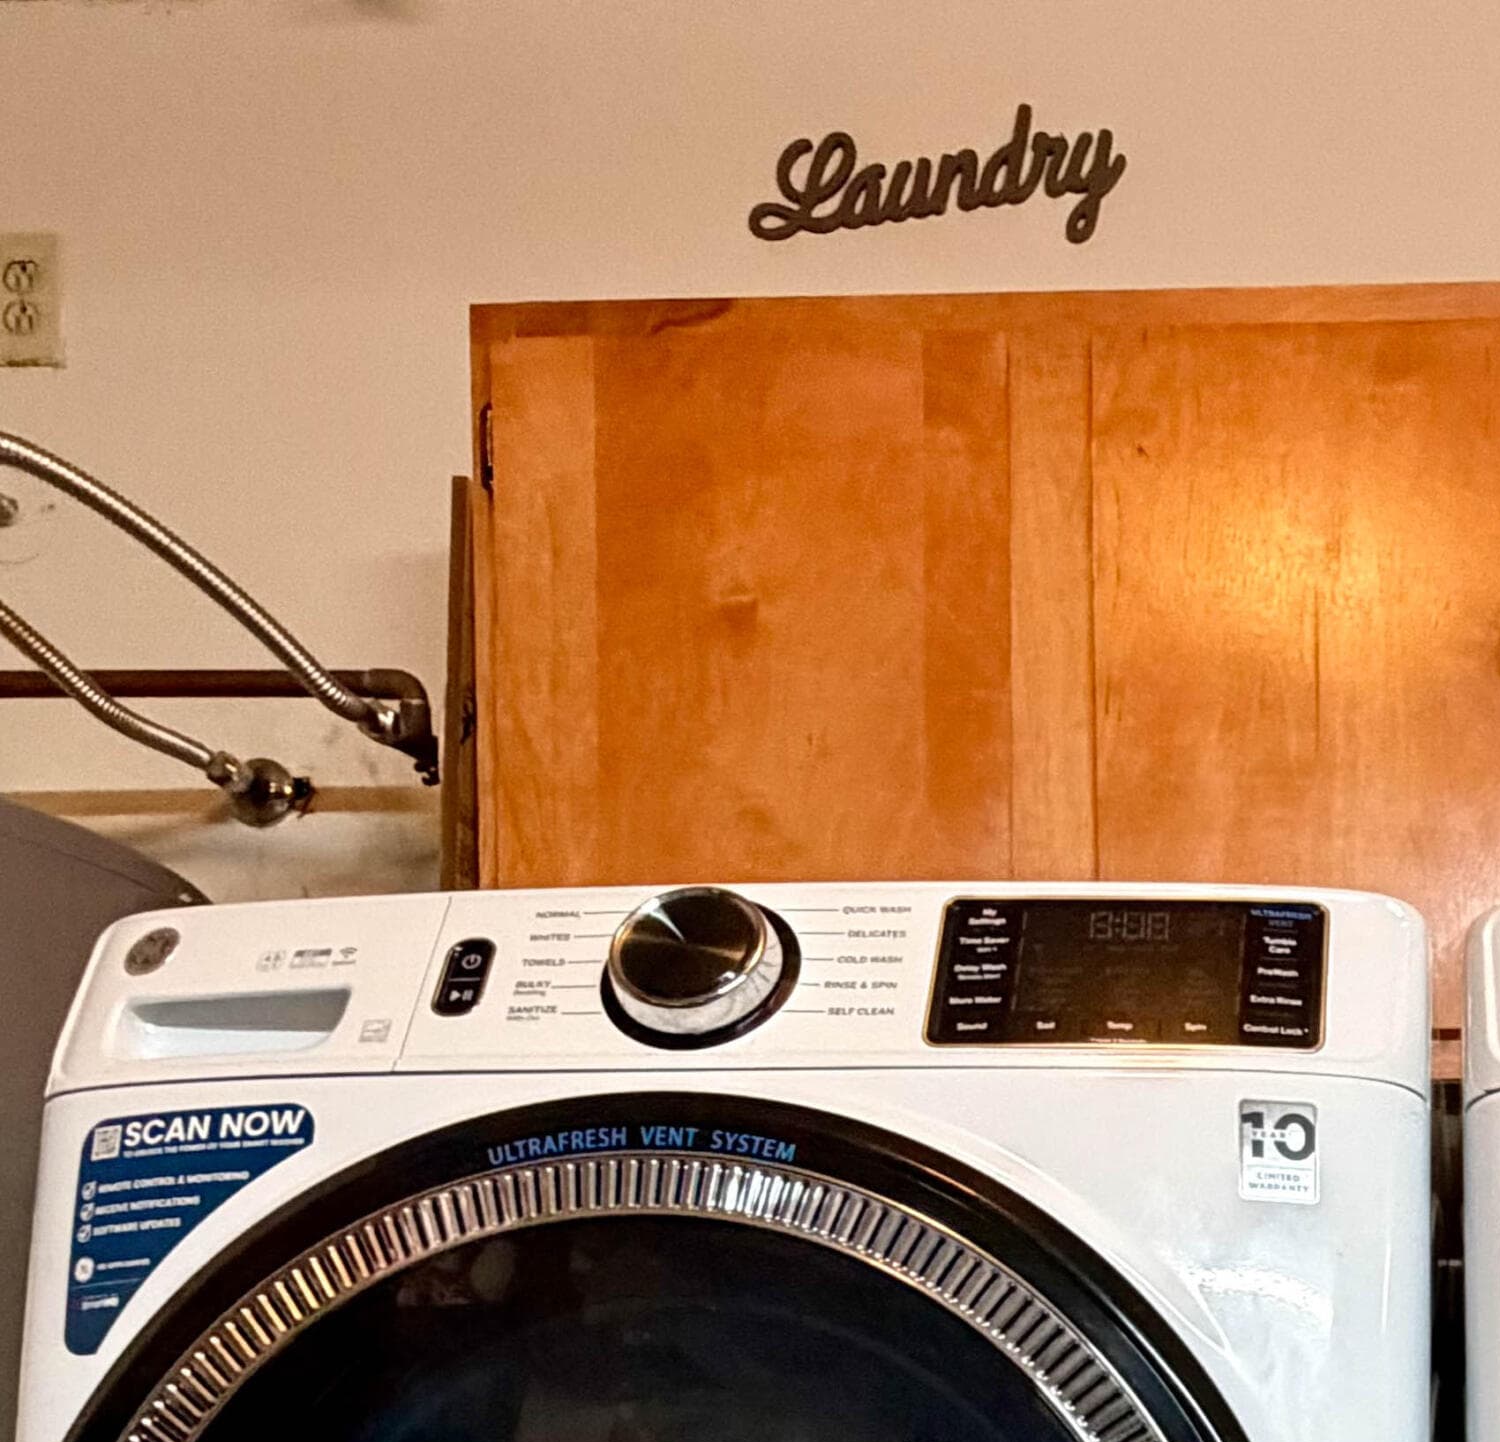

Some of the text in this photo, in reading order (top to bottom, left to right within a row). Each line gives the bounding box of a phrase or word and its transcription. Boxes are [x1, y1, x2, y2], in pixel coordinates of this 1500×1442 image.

[748, 103, 1127, 244] Laundry
[842, 906, 912, 915] QUICK WASH
[847, 930, 907, 939] DELICATES
[522, 958, 566, 967] TOWELS
[837, 956, 903, 964] COLD WASH
[824, 980, 858, 989] RINSE
[871, 980, 898, 989] SPIN
[508, 1005, 558, 1015] SANITIZE
[827, 1007, 895, 1016] SELF CLEAN
[124, 1109, 305, 1147] SCAN NOW
[1241, 1111, 1316, 1162] 10
[487, 1126, 798, 1167] ULTRAFRESH VENT SYSTEM
